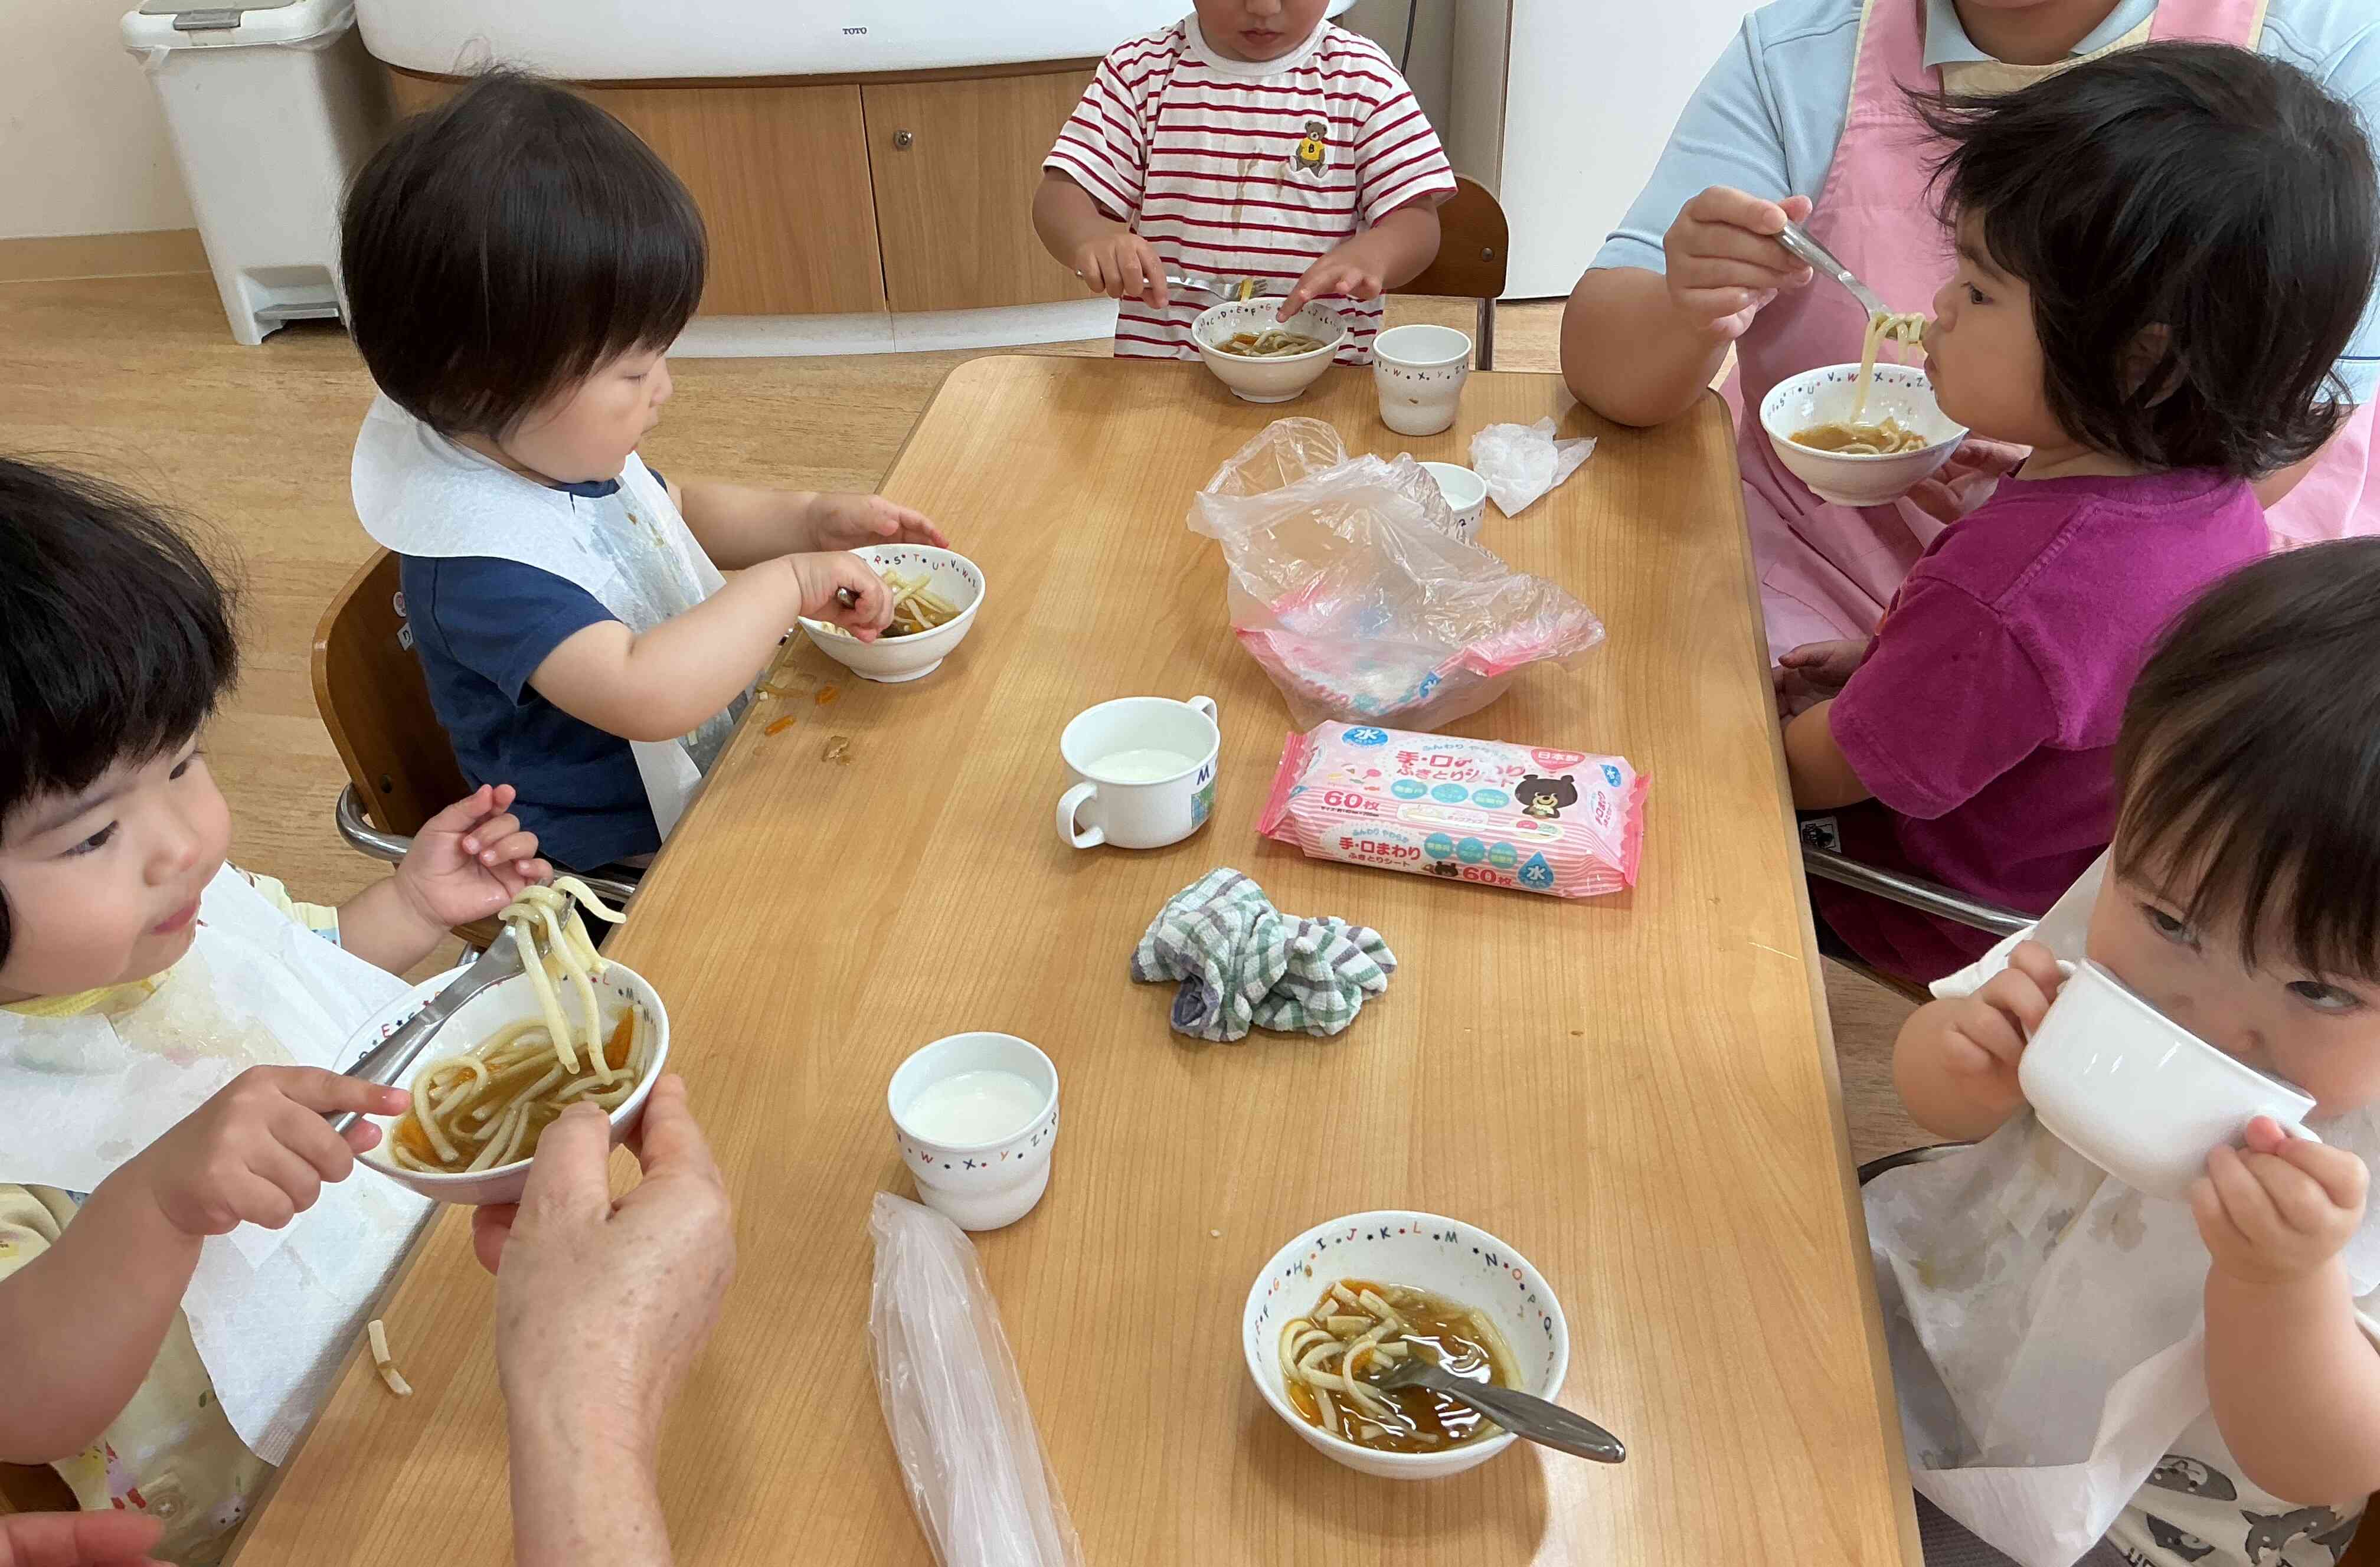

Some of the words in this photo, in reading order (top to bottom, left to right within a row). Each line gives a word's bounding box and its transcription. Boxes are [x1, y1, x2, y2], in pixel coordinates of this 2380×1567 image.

[842, 27, 867, 35] TOTO
[1393, 368, 1401, 377] W
[1418, 372, 1426, 381] X
[1807, 387, 1815, 395] U
[1828, 372, 1835, 382] V
[1846, 373, 1859, 382] W
[1875, 372, 1883, 382] X
[1917, 378, 1923, 387] Z
[874, 555, 881, 564] R
[894, 557, 901, 565] S
[914, 554, 920, 562] T
[933, 562, 939, 571] U
[1354, 729, 1379, 740] 水
[1196, 765, 1209, 785] M
[1323, 791, 1380, 811] 60枚
[1339, 836, 1421, 861] 手・口まわり
[1348, 852, 1410, 867] ふきとりシート
[1463, 866, 1512, 885] 60枚
[1526, 865, 1545, 881] 水
[381, 1023, 392, 1039] E
[921, 1151, 933, 1163] W
[963, 1159, 976, 1170] X
[1001, 1151, 1010, 1162] Y
[1031, 1134, 1039, 1147] Z
[1263, 1304, 1269, 1318] F
[1294, 1260, 1302, 1275] H
[1316, 1238, 1326, 1251] I
[1346, 1228, 1357, 1241] J
[1380, 1226, 1391, 1239] K
[1413, 1221, 1421, 1234] L
[1445, 1231, 1459, 1244] M
[1485, 1252, 1498, 1267] N
[1512, 1268, 1522, 1280] O
[1528, 1294, 1536, 1303] P
[1544, 1316, 1552, 1332] Q
